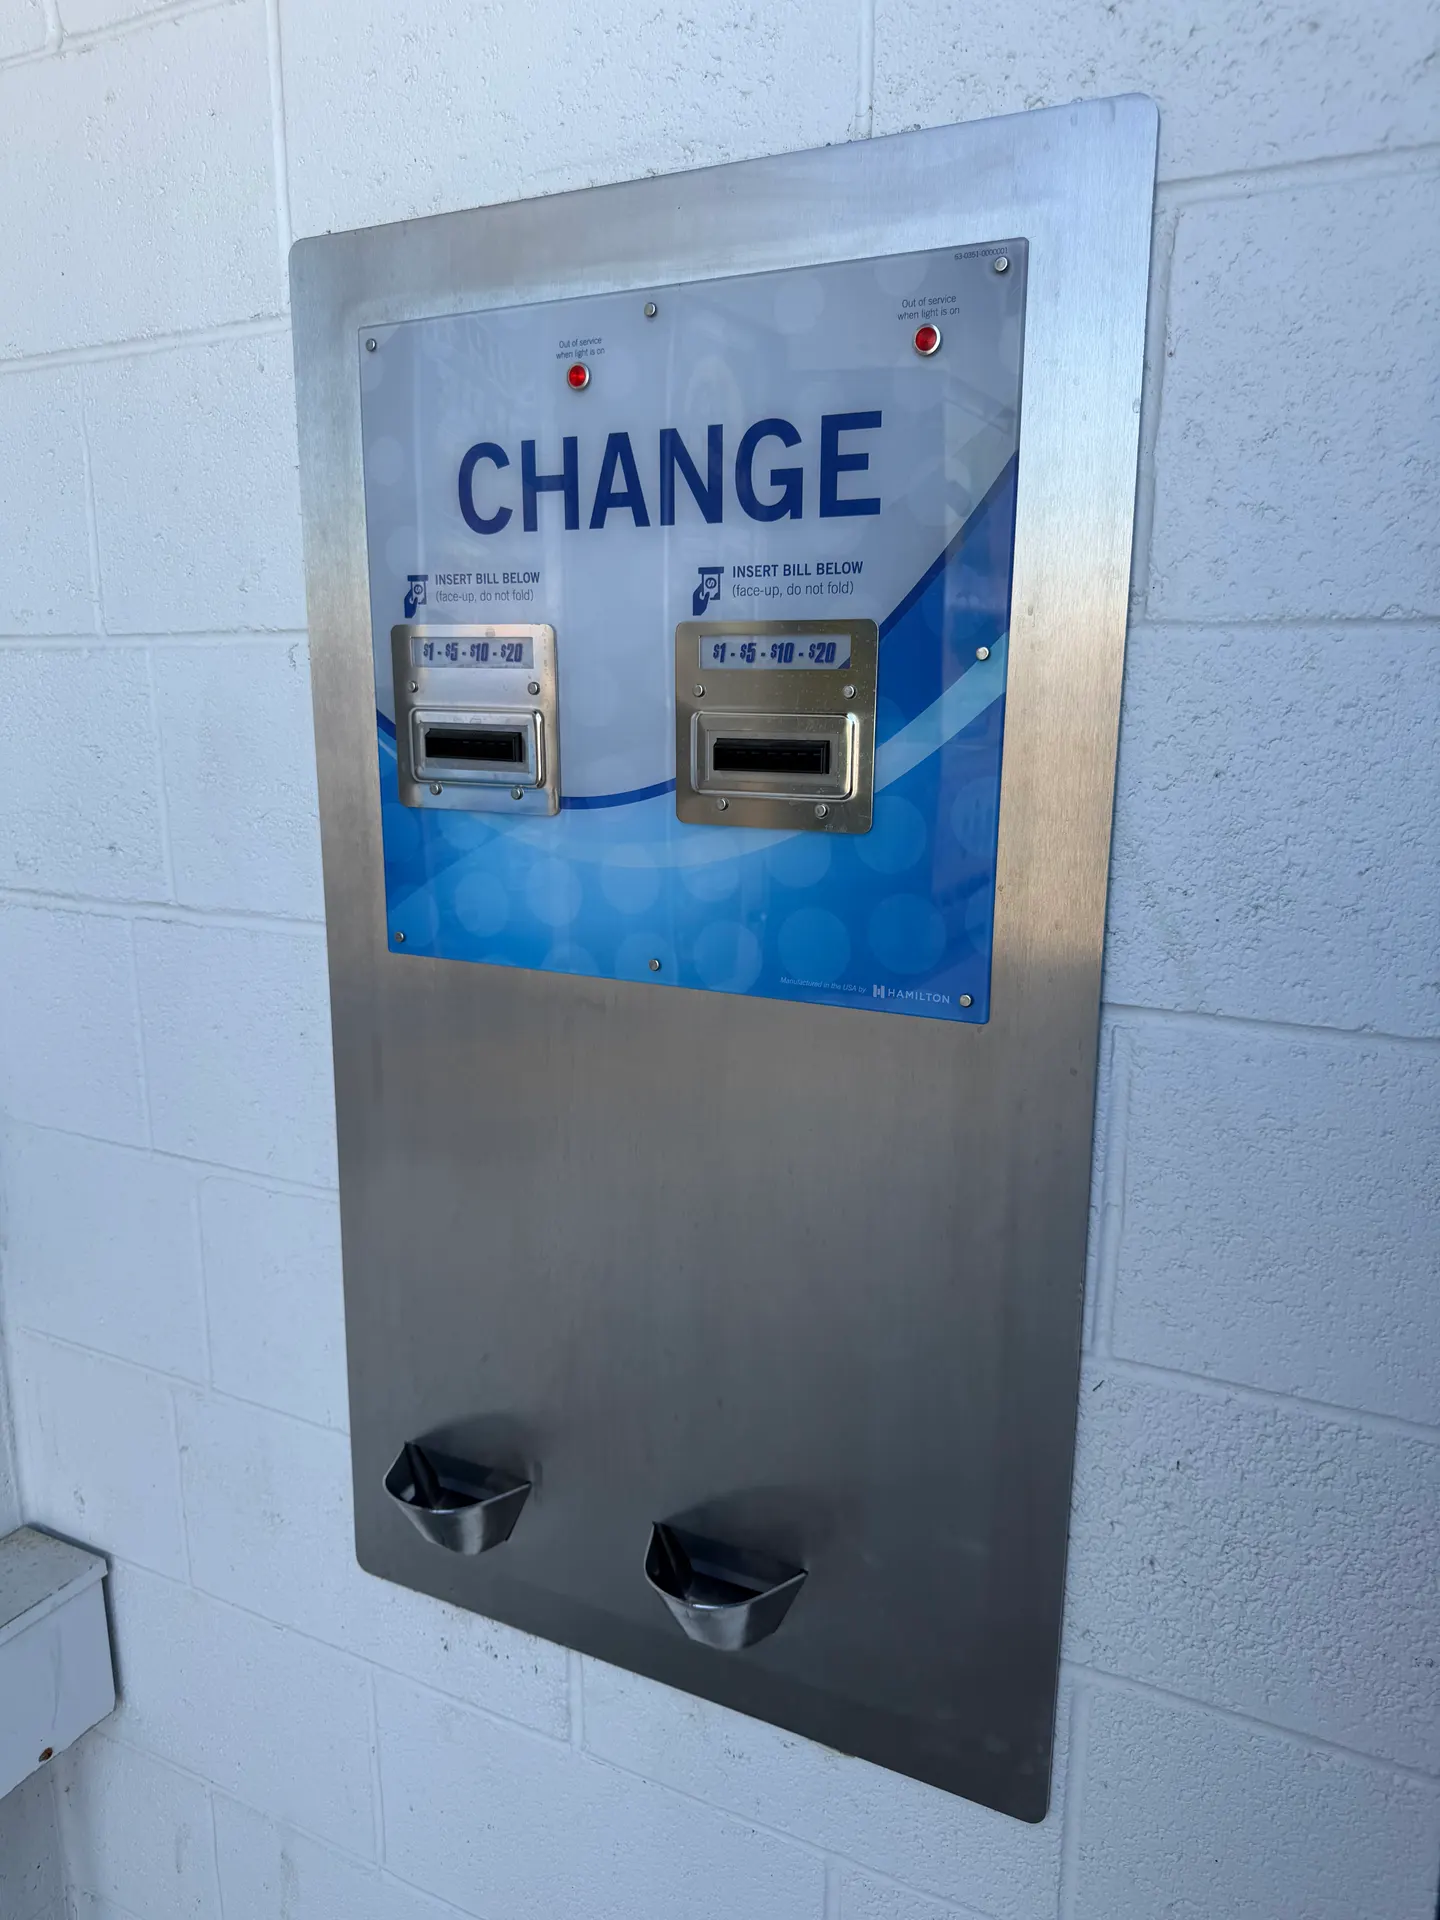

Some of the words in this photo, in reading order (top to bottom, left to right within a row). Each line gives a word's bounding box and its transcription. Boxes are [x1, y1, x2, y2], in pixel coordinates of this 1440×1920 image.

[902, 299, 916, 309] Out
[918, 297, 926, 307] of
[928, 295, 956, 306] service
[897, 311, 919, 321] when
[921, 308, 939, 320] light
[940, 306, 948, 316] is
[949, 307, 960, 315] on
[558, 340, 571, 349] Out
[571, 338, 578, 347] of
[580, 337, 602, 346] service
[556, 351, 573, 360] when
[574, 349, 588, 359] light
[590, 348, 596, 356] is
[457, 410, 883, 535] CHANGE
[435, 573, 472, 586] INSERT
[475, 572, 499, 585] BILL
[502, 571, 541, 584] BELOW
[732, 564, 779, 579] INSERT
[783, 563, 812, 577] BILL
[816, 561, 864, 576] BELOW
[436, 590, 477, 604] (face-up,
[480, 590, 492, 602] do
[494, 590, 510, 601] not
[512, 588, 534, 602] fold)
[732, 584, 783, 599] (face-up,
[786, 583, 802, 596] do
[805, 583, 824, 595] not
[827, 580, 854, 595] fold)
[423, 642, 434, 661] $1
[445, 642, 459, 661] $5
[469, 642, 489, 662] $10
[500, 642, 523, 663] $20
[712, 642, 727, 663] $1
[739, 642, 757, 663] $5
[770, 642, 795, 664] $10
[808, 642, 837, 664] $20
[780, 976, 823, 988] Manufactured
[830, 982, 842, 990] the
[842, 984, 857, 992] USA
[858, 986, 867, 994] by
[887, 988, 951, 1004] HAMILTON
